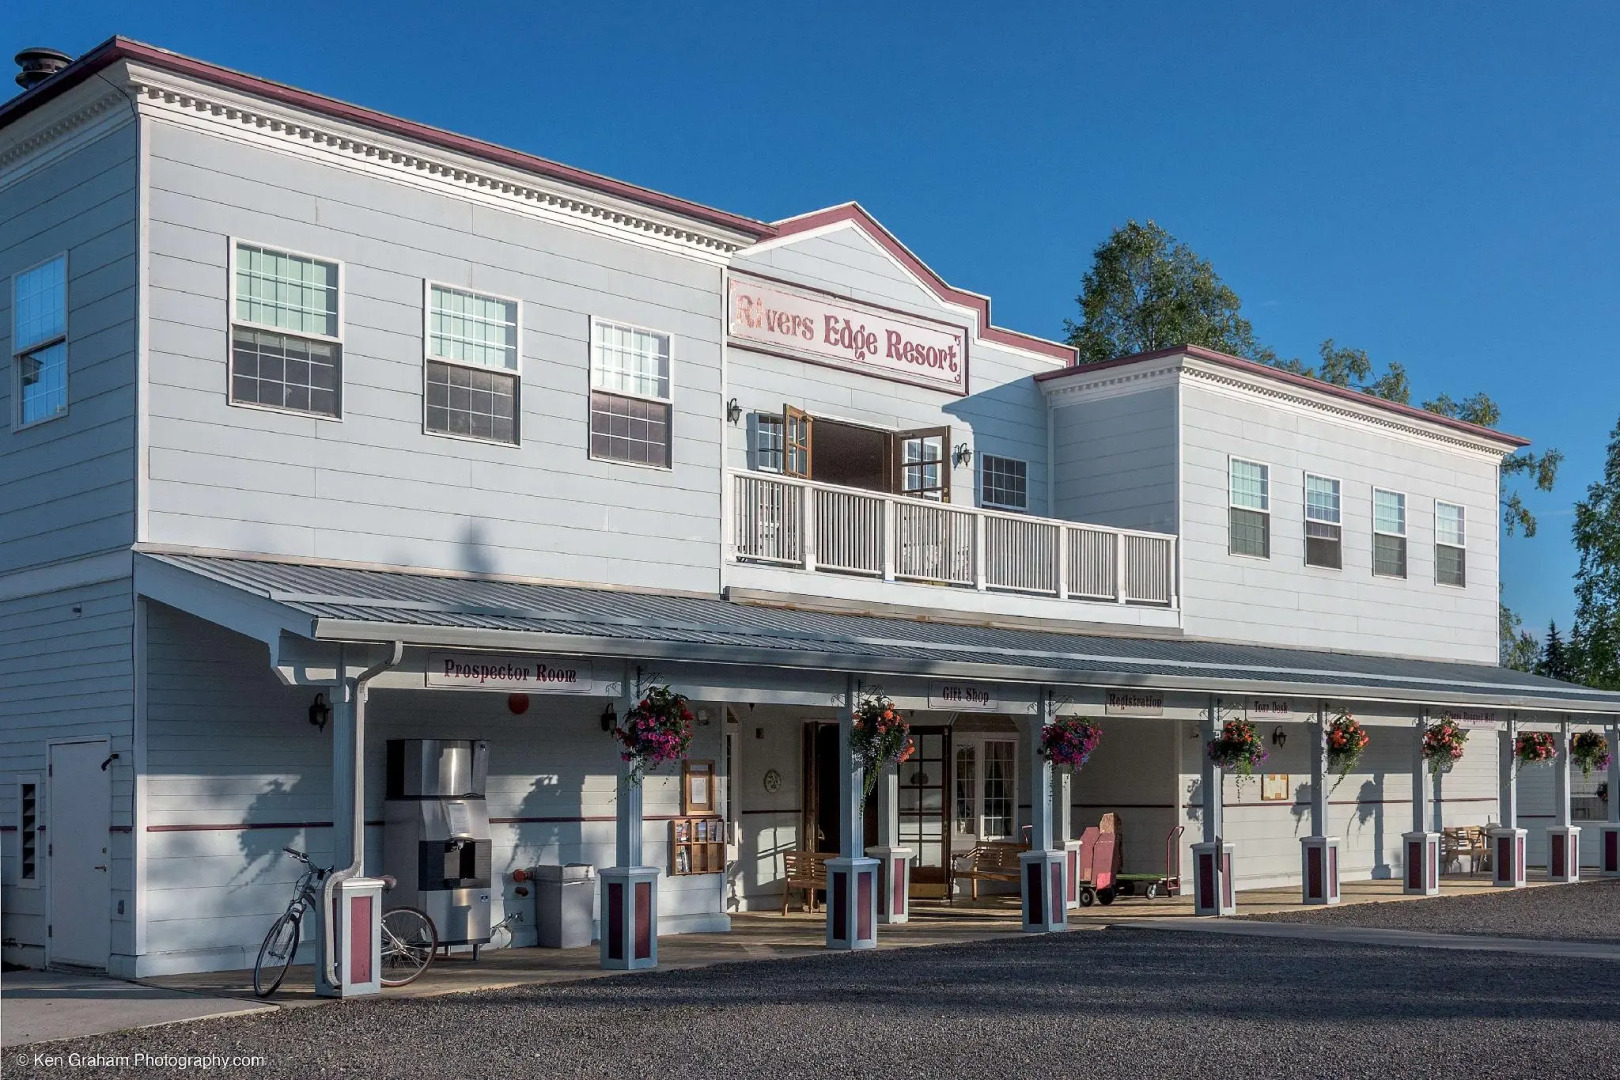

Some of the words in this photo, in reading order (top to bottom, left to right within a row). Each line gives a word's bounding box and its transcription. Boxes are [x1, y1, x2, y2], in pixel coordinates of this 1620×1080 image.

[735, 294, 815, 342] Rivers
[823, 313, 878, 361] Edge
[885, 328, 958, 373] Resort
[444, 658, 530, 684] Prospector
[536, 663, 577, 683] Room
[942, 686, 962, 702] Gift
[966, 687, 989, 706] Shop
[1109, 693, 1162, 710] Registration
[1254, 700, 1270, 713] Tour
[1272, 701, 1288, 714] Desk
